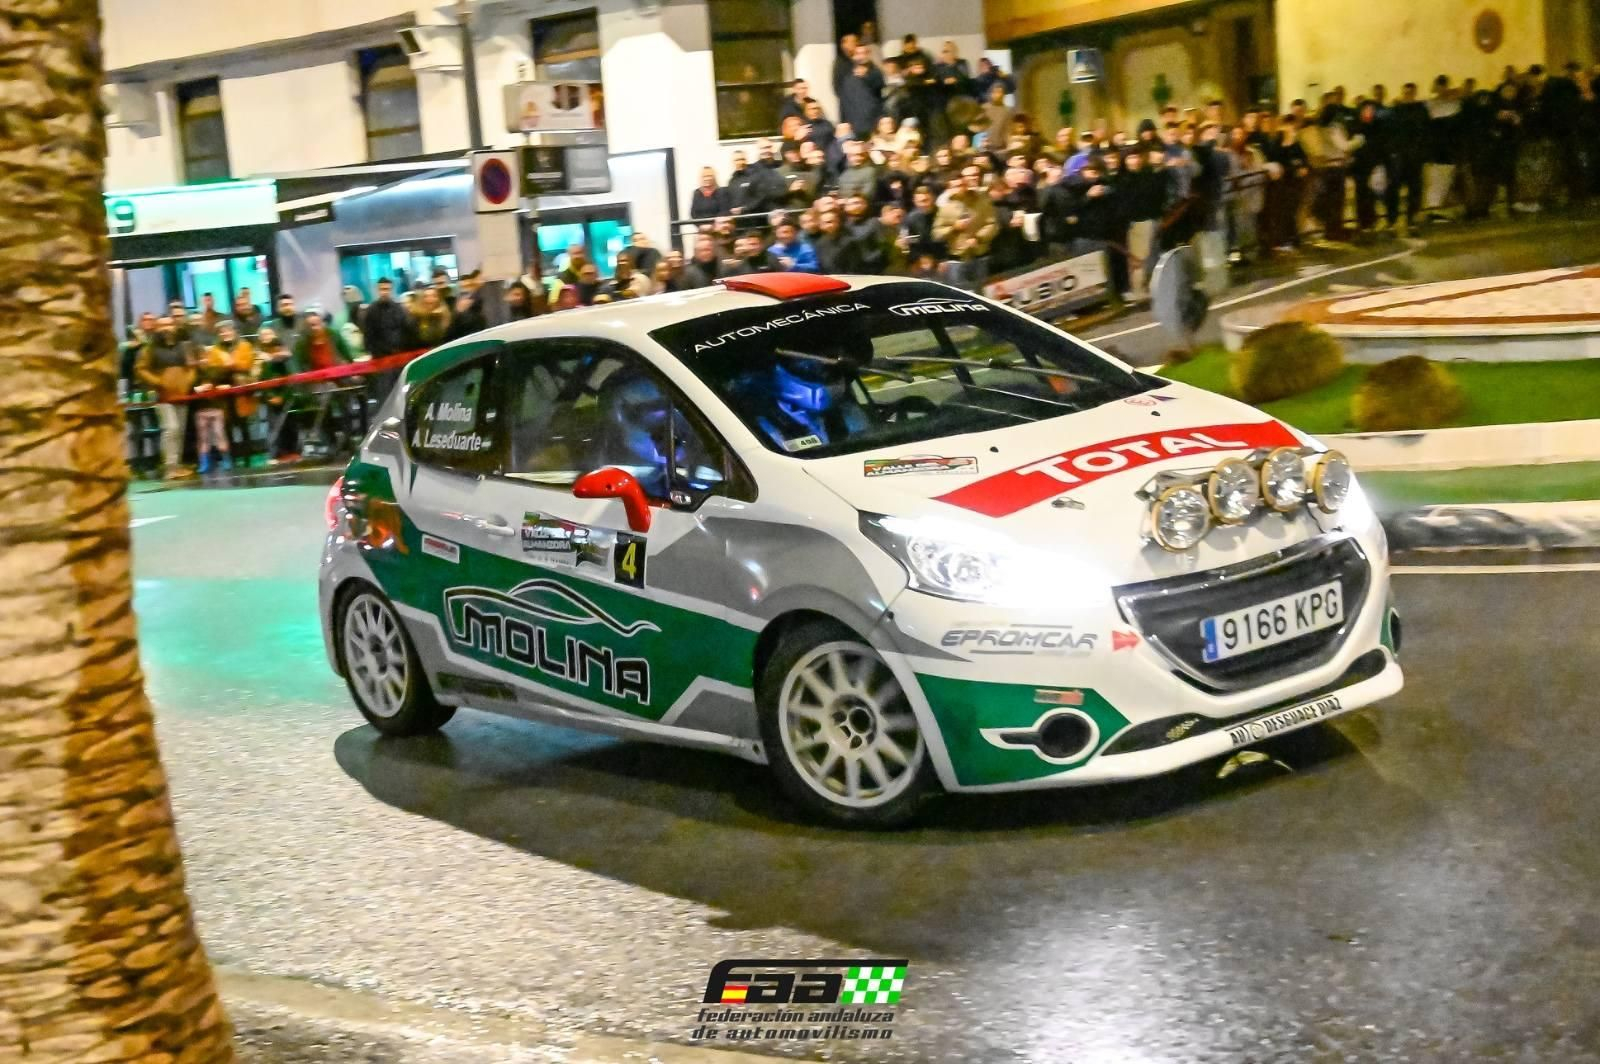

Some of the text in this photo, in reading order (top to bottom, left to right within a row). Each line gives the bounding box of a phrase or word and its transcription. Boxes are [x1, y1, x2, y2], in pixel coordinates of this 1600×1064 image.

[694, 302, 871, 353] AUTOMECÁNICA
[892, 302, 990, 317] MOLINA
[437, 402, 473, 422] Molina
[423, 429, 481, 451] Leseduarte
[1016, 432, 1249, 484] TOTAL
[621, 542, 637, 580] 4
[1223, 588, 1338, 650] 9166 KPG
[450, 601, 651, 706] MOLINA
[940, 629, 1098, 649] EPROMCAR
